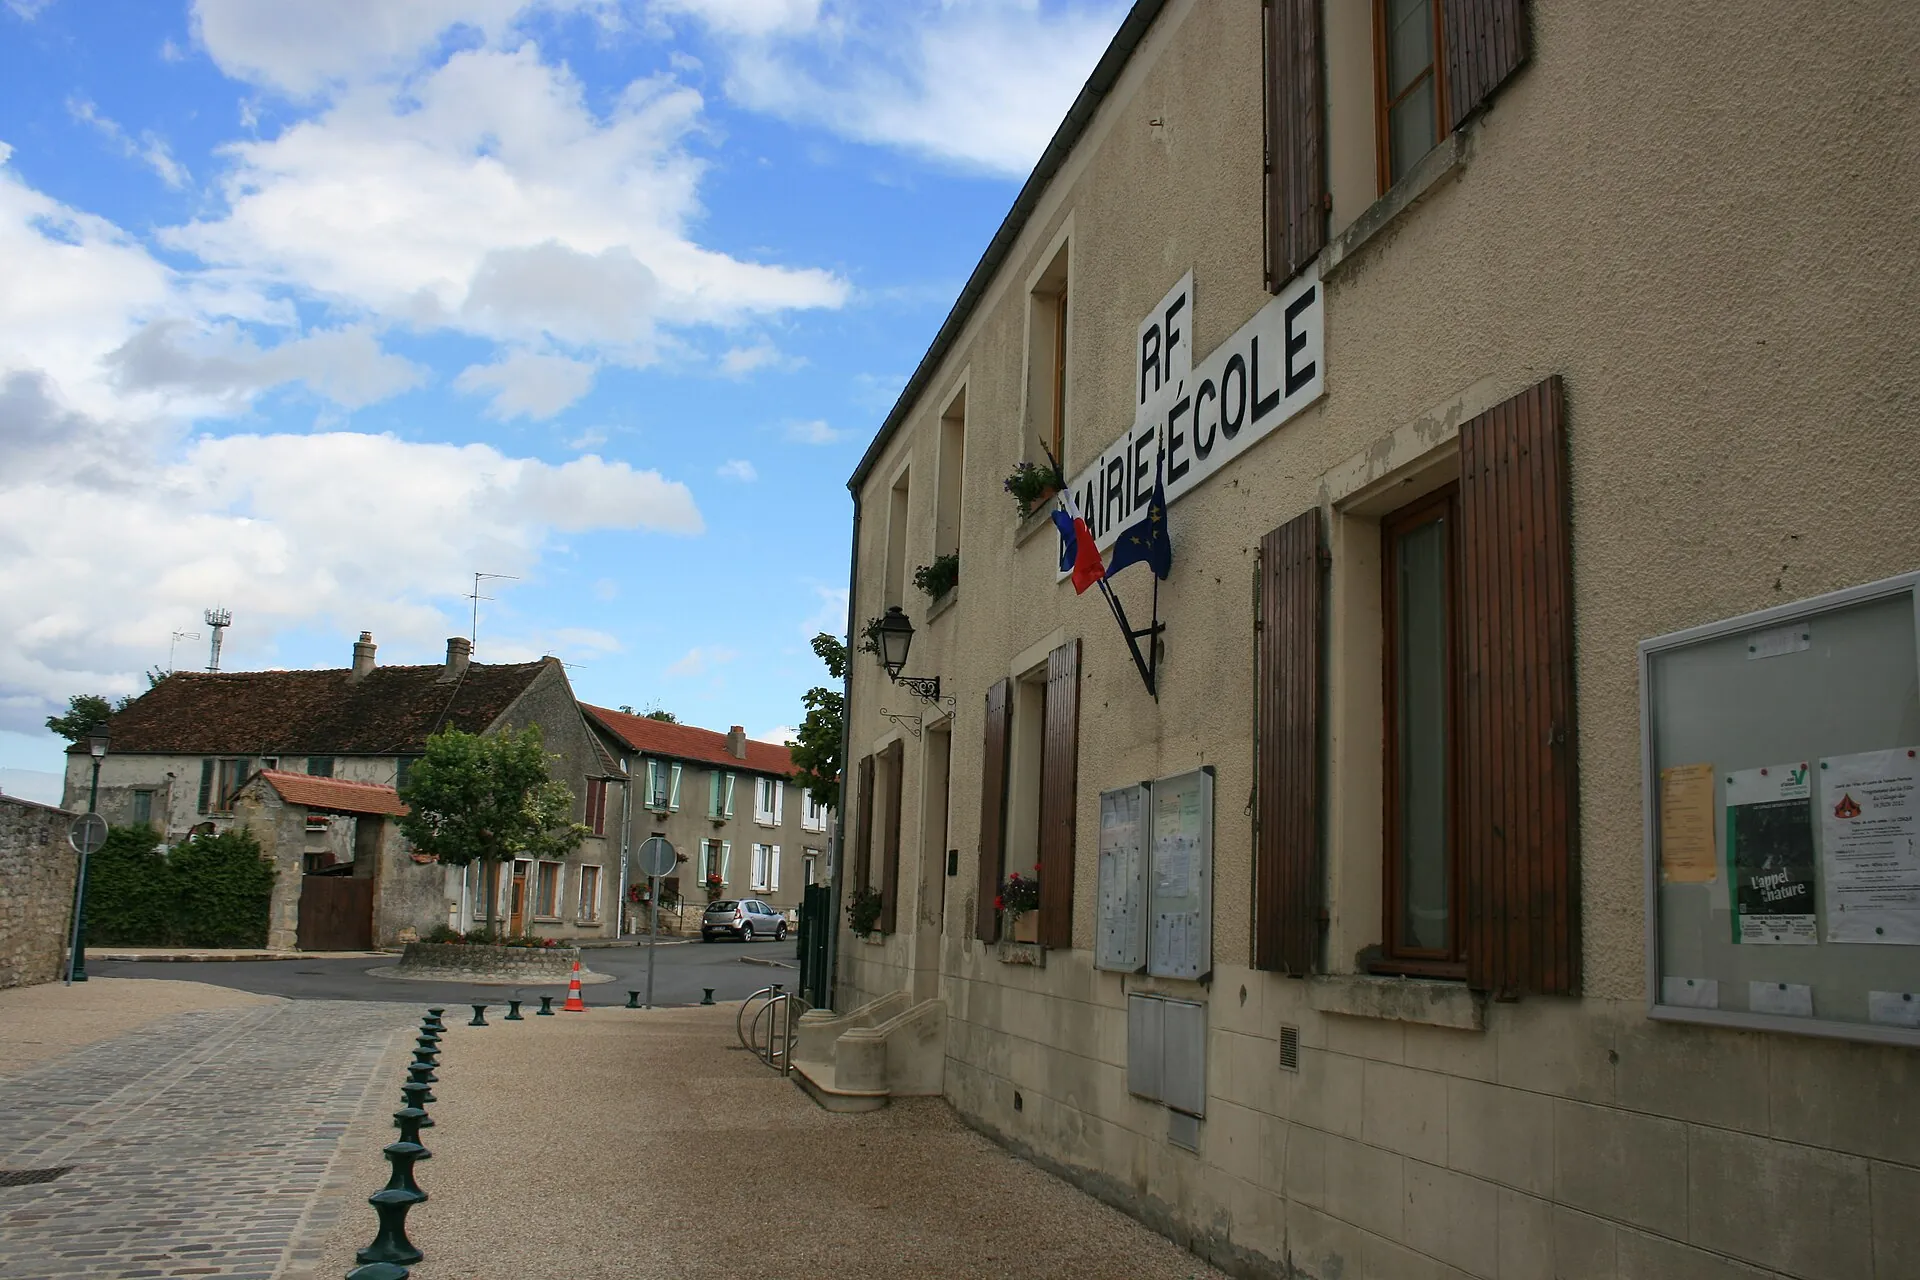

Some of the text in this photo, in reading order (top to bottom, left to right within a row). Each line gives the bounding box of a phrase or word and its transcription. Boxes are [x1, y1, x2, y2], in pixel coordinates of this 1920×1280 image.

[1138, 291, 1186, 405] RF
[1751, 867, 1789, 890] L'appel
[1766, 883, 1806, 901] nature
